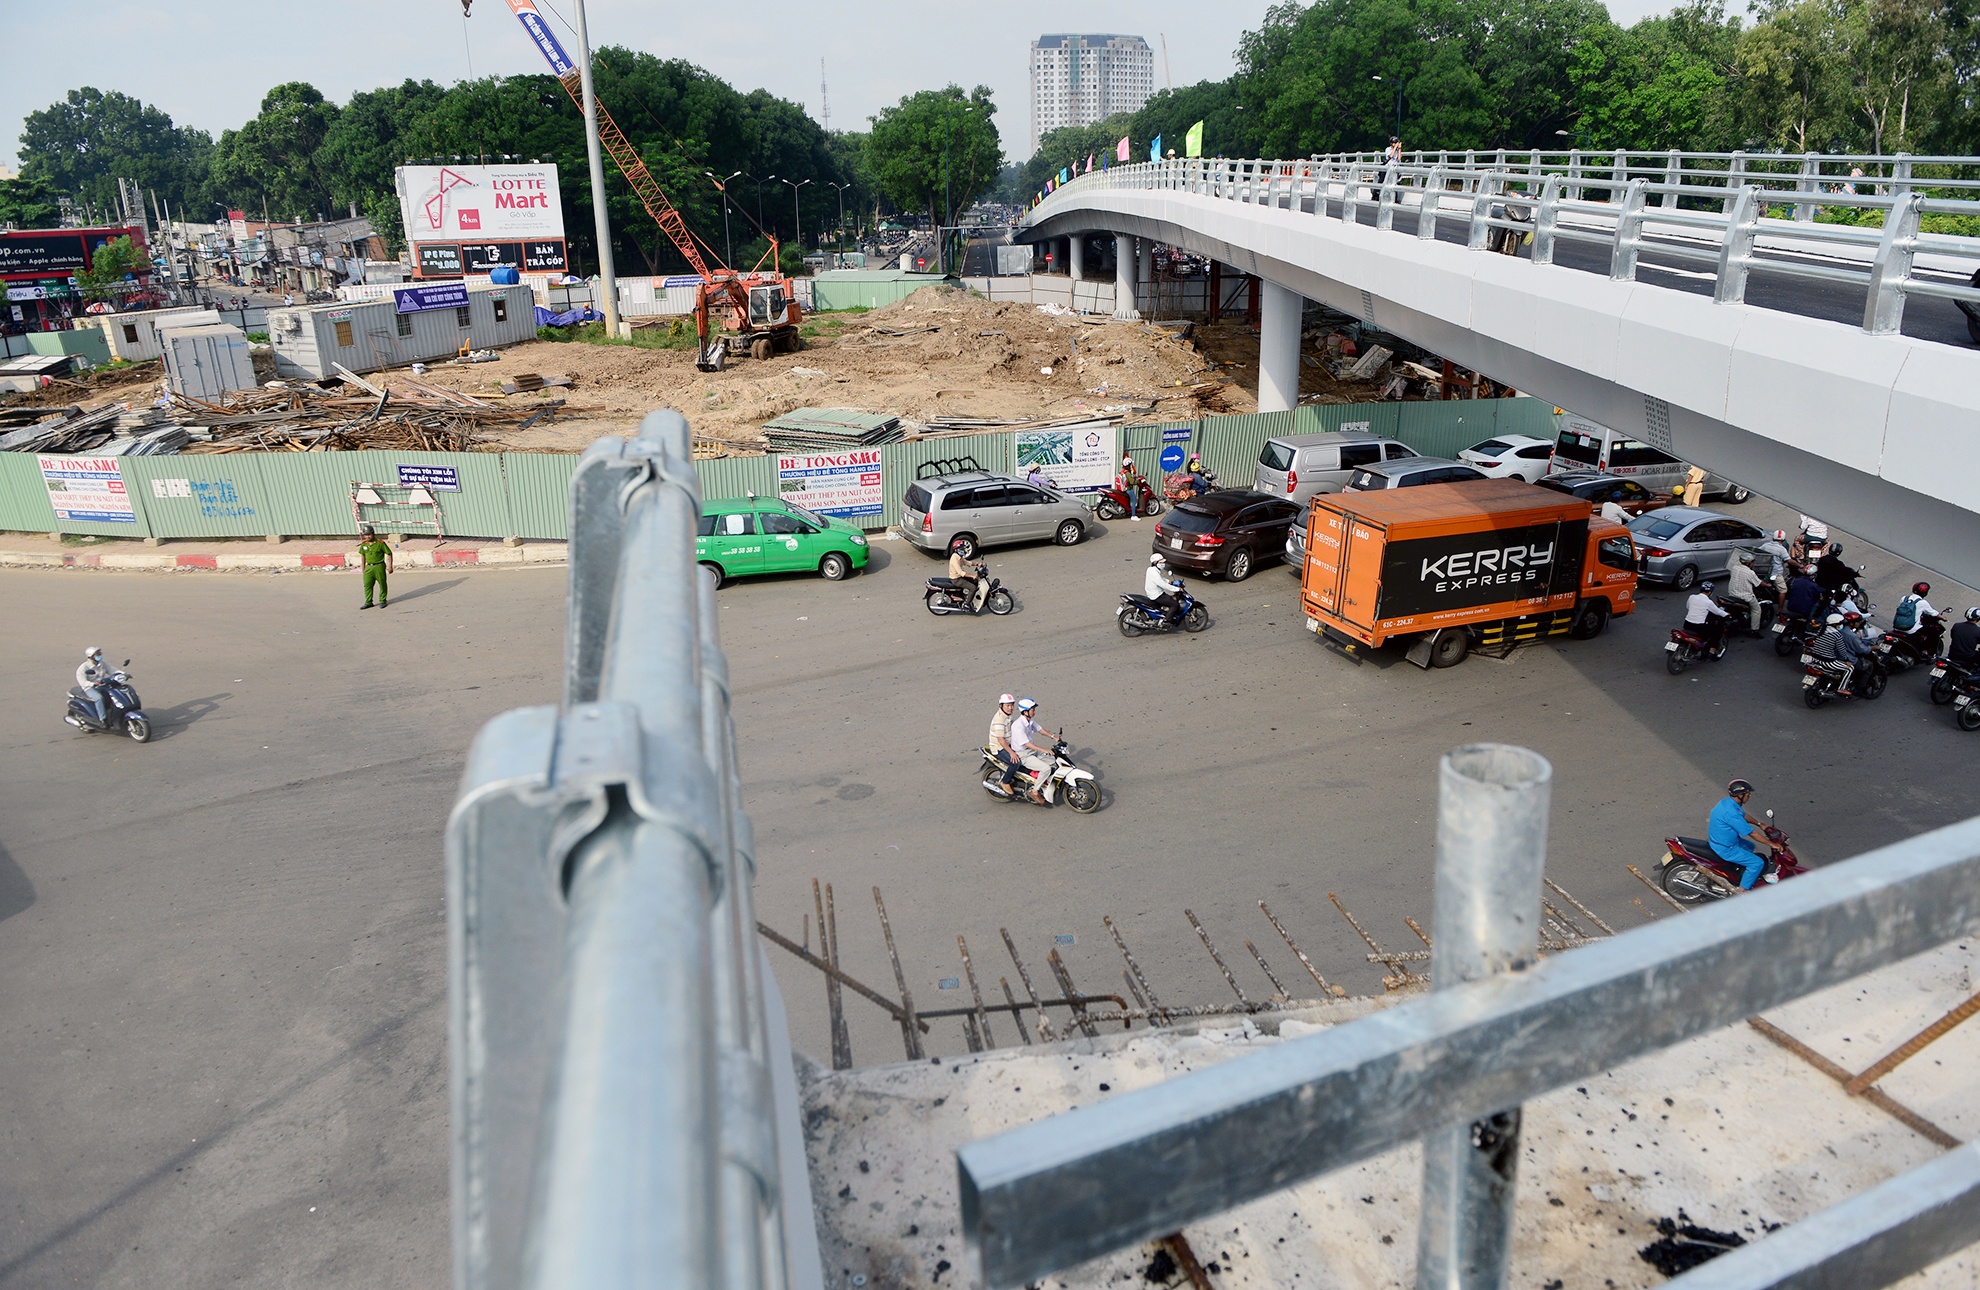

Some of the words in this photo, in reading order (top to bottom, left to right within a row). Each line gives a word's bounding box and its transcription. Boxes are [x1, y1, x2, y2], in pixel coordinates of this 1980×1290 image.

[492, 179, 546, 190] LOTTE
[495, 192, 549, 209] Mart
[439, 250, 456, 258] Plus
[535, 244, 553, 254] BÁN
[60, 458, 92, 471] TÔNG
[780, 456, 799, 469] BÊ
[804, 455, 847, 468] TÔNG
[849, 451, 880, 464] SMC
[1641, 467, 1660, 475] DCAR
[1328, 519, 1336, 528] XE
[1356, 528, 1369, 540] BÁO
[1314, 531, 1340, 547] KERRY
[1421, 541, 1554, 581] KERRY
[1435, 570, 1537, 593] EXPRESS
[1397, 618, 1414, 627] 224.37
